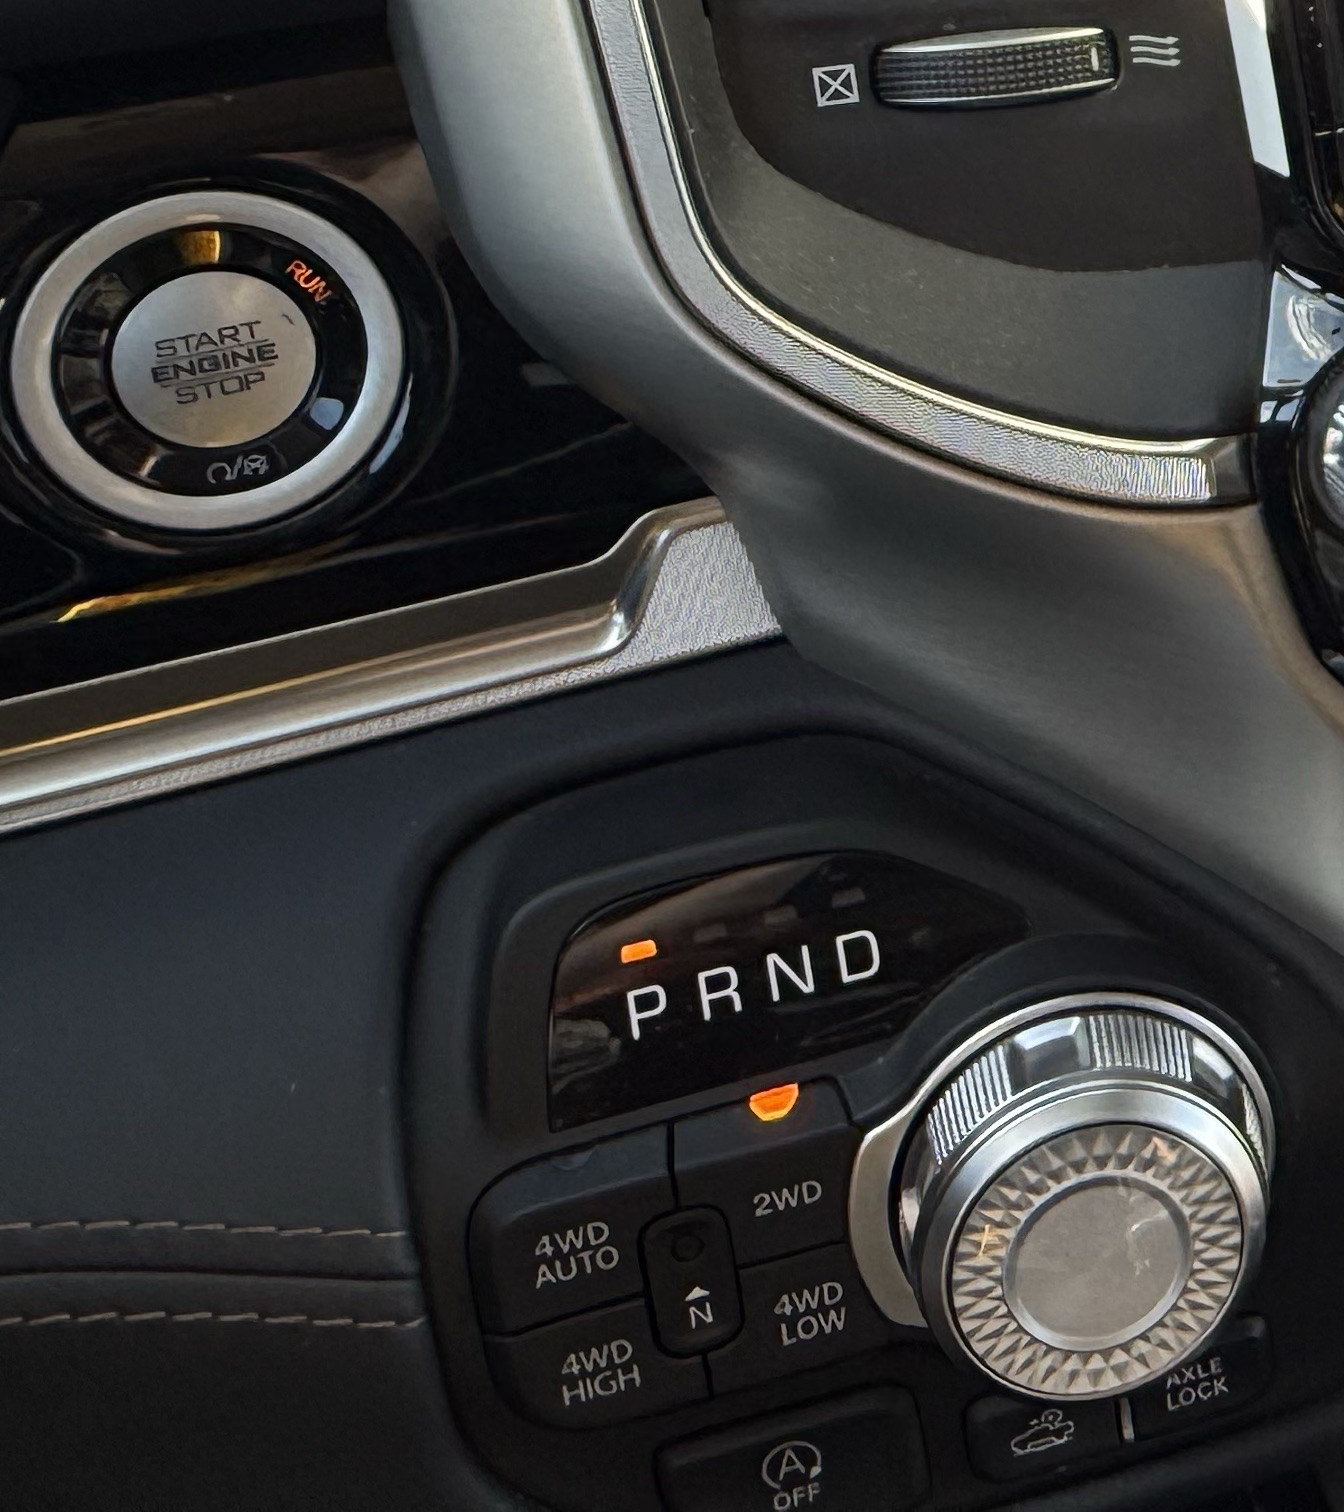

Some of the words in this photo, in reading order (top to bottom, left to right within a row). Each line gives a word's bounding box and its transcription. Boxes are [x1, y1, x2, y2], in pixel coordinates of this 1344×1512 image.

[284, 259, 333, 303] RUN
[154, 319, 262, 358] START
[150, 341, 279, 384] ENGINE
[174, 369, 266, 405] STOP
[625, 983, 667, 1042] P
[696, 964, 743, 1022] R
[765, 944, 815, 1003] N
[835, 928, 881, 984] D
[751, 1179, 823, 1218] 2WD
[534, 1220, 611, 1258] 4WD
[535, 1245, 620, 1290] AUTO
[688, 1302, 714, 1330] N
[772, 1280, 844, 1317] 4WD
[779, 1306, 847, 1347] LOW
[561, 1338, 634, 1376] 4WD
[1165, 1355, 1224, 1389] AXLE
[561, 1363, 642, 1407] HIGH
[1165, 1376, 1229, 1413] LOCK
[772, 1481, 822, 1511] OFF
